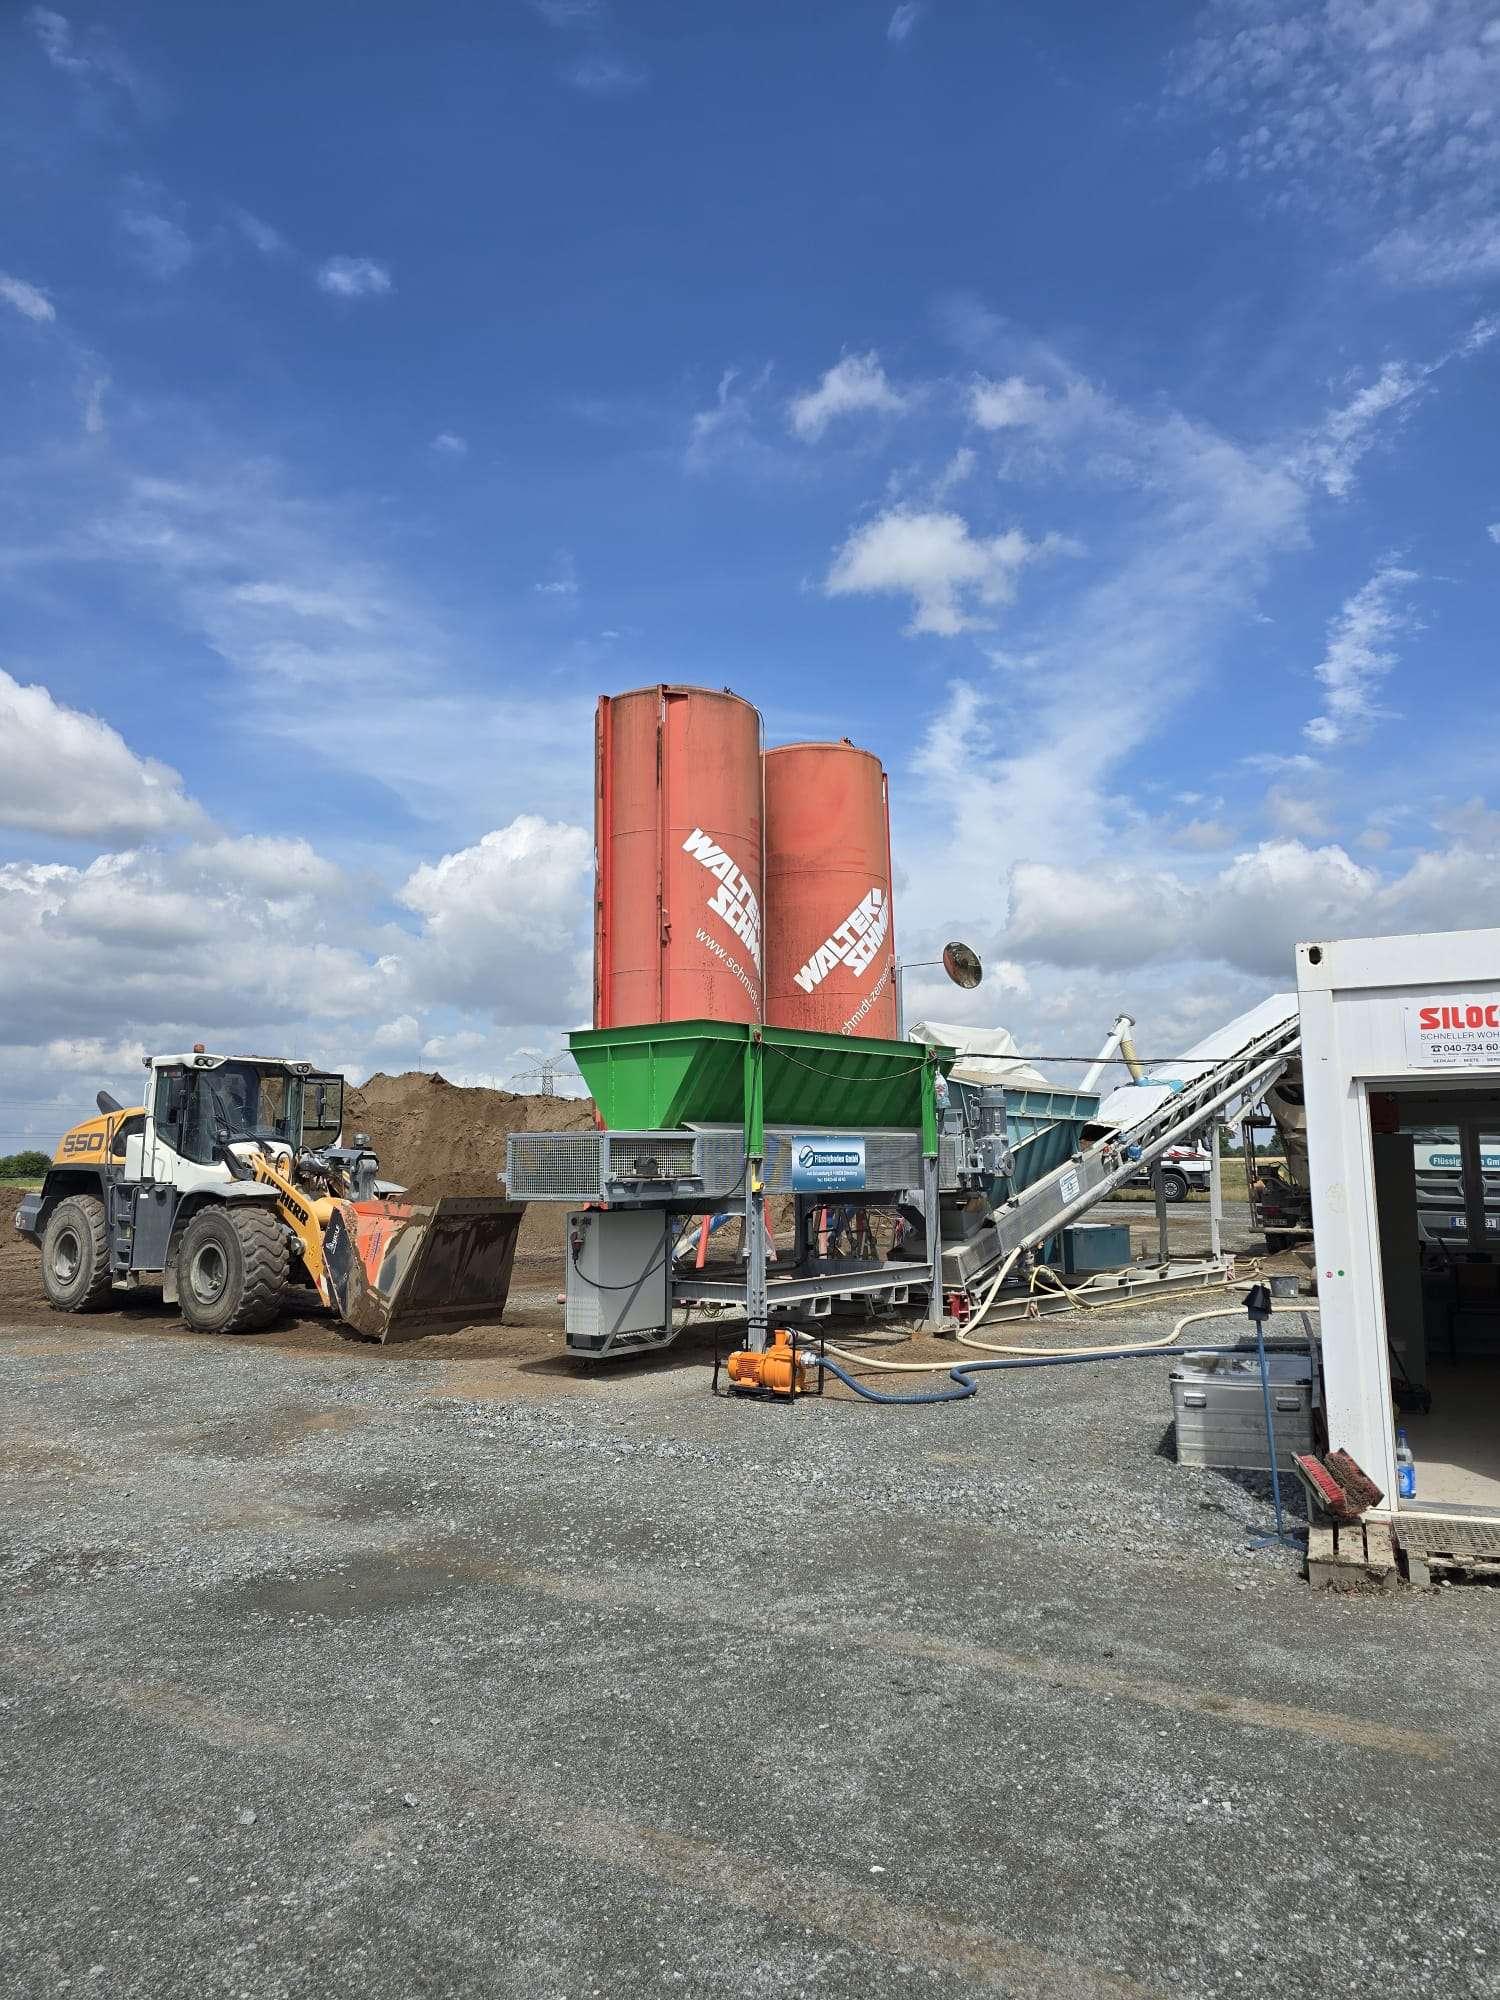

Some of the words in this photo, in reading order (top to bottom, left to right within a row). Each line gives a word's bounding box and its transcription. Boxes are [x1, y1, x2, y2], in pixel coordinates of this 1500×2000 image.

[1420, 1031, 1474, 1041] SCHNELLER
[1477, 1030, 1500, 1039] WOH
[1443, 1043, 1483, 1052] 040-734
[63, 1133, 104, 1152] 550
